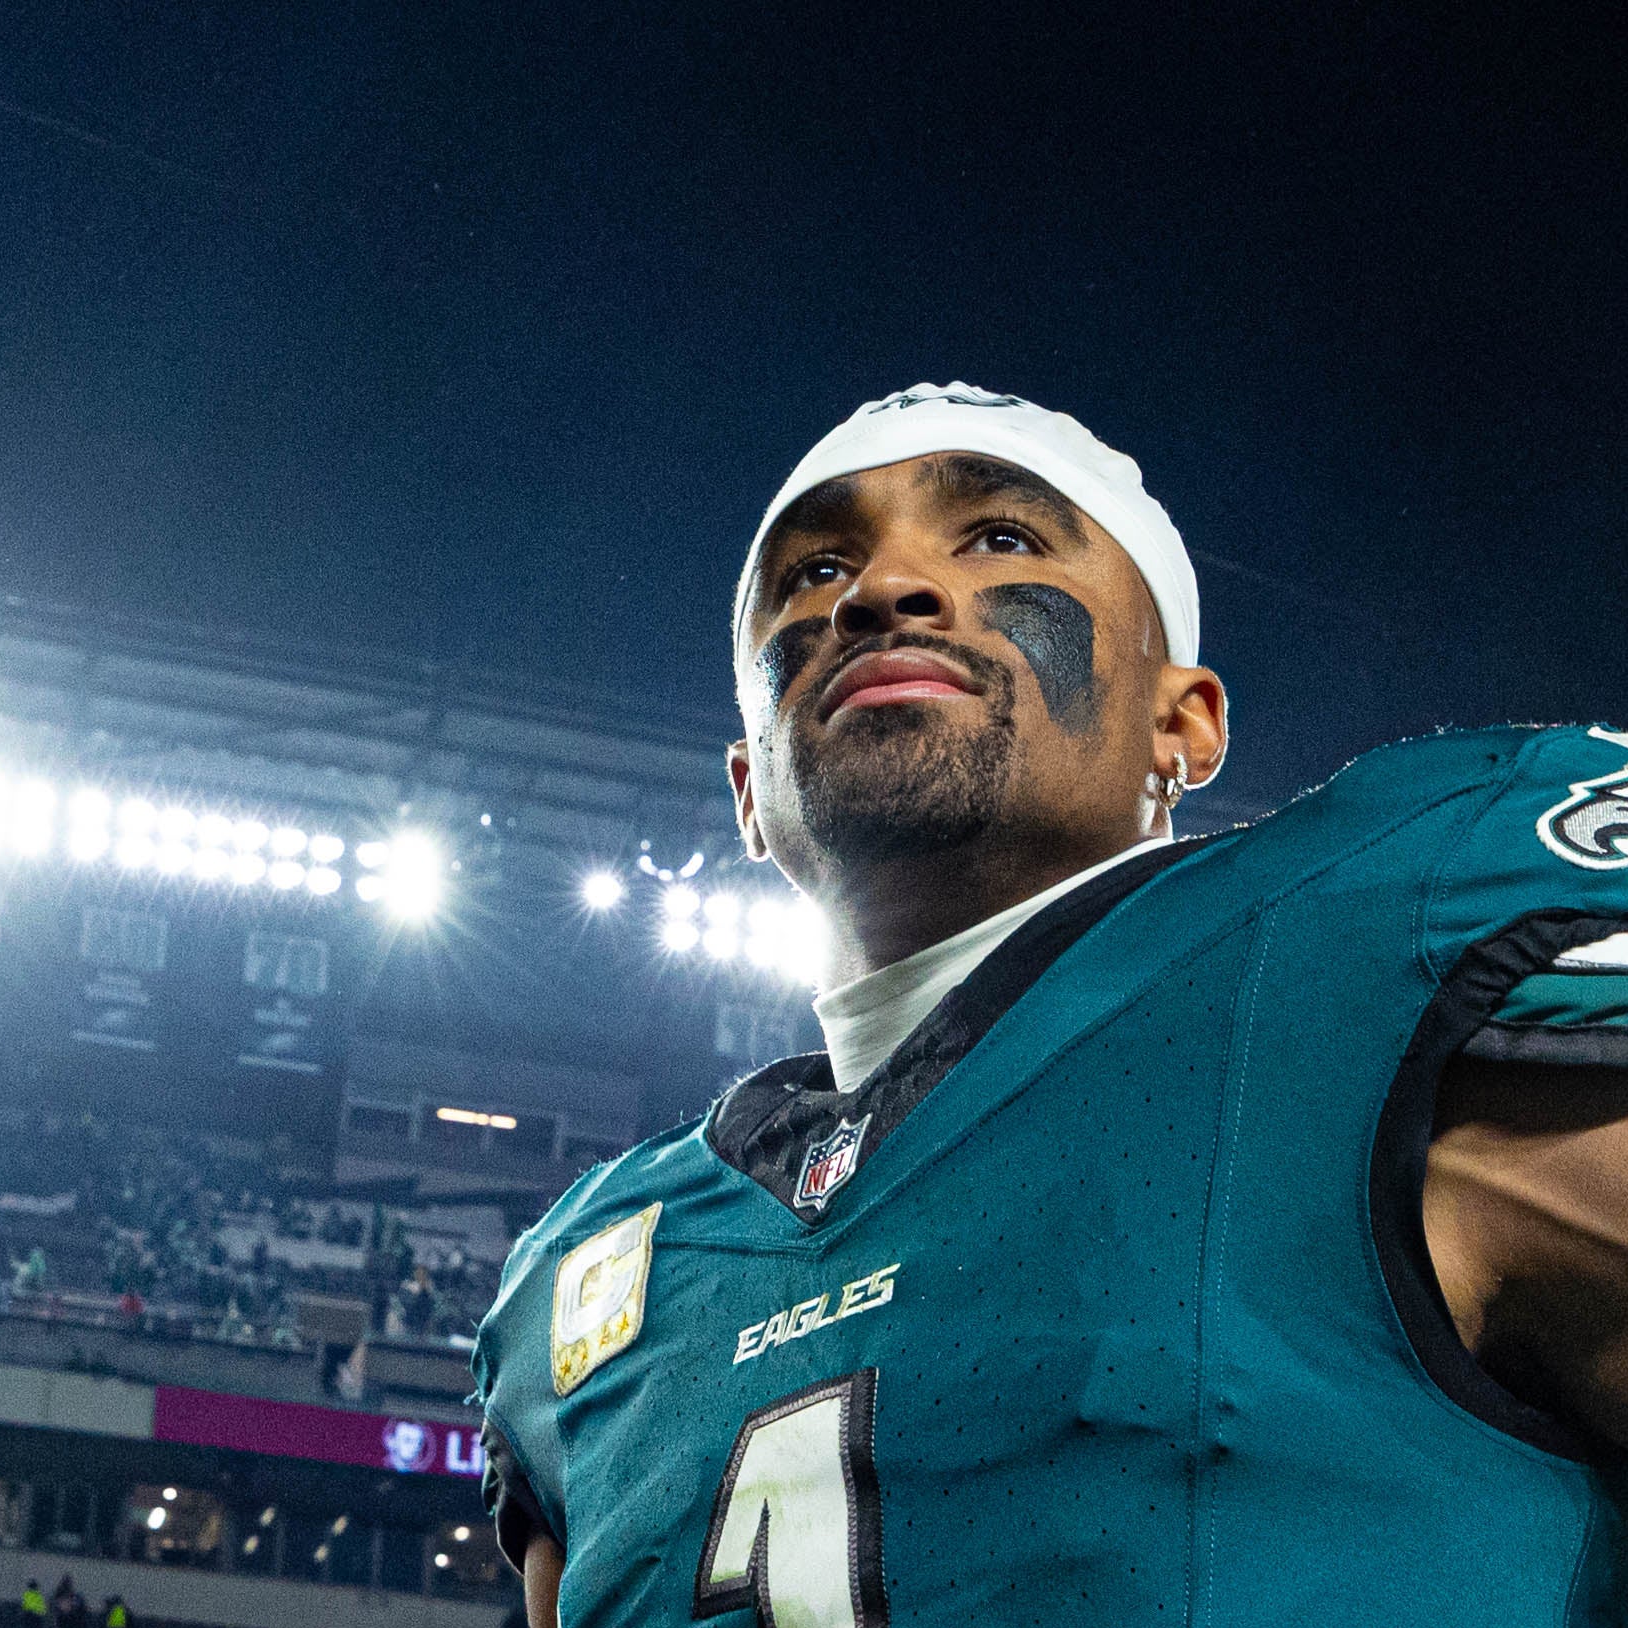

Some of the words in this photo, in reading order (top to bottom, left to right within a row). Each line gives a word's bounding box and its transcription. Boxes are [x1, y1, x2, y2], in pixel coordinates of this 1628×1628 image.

[804, 1153, 847, 1195] NFL
[556, 1219, 645, 1345] C
[733, 1263, 901, 1365] EAGLES
